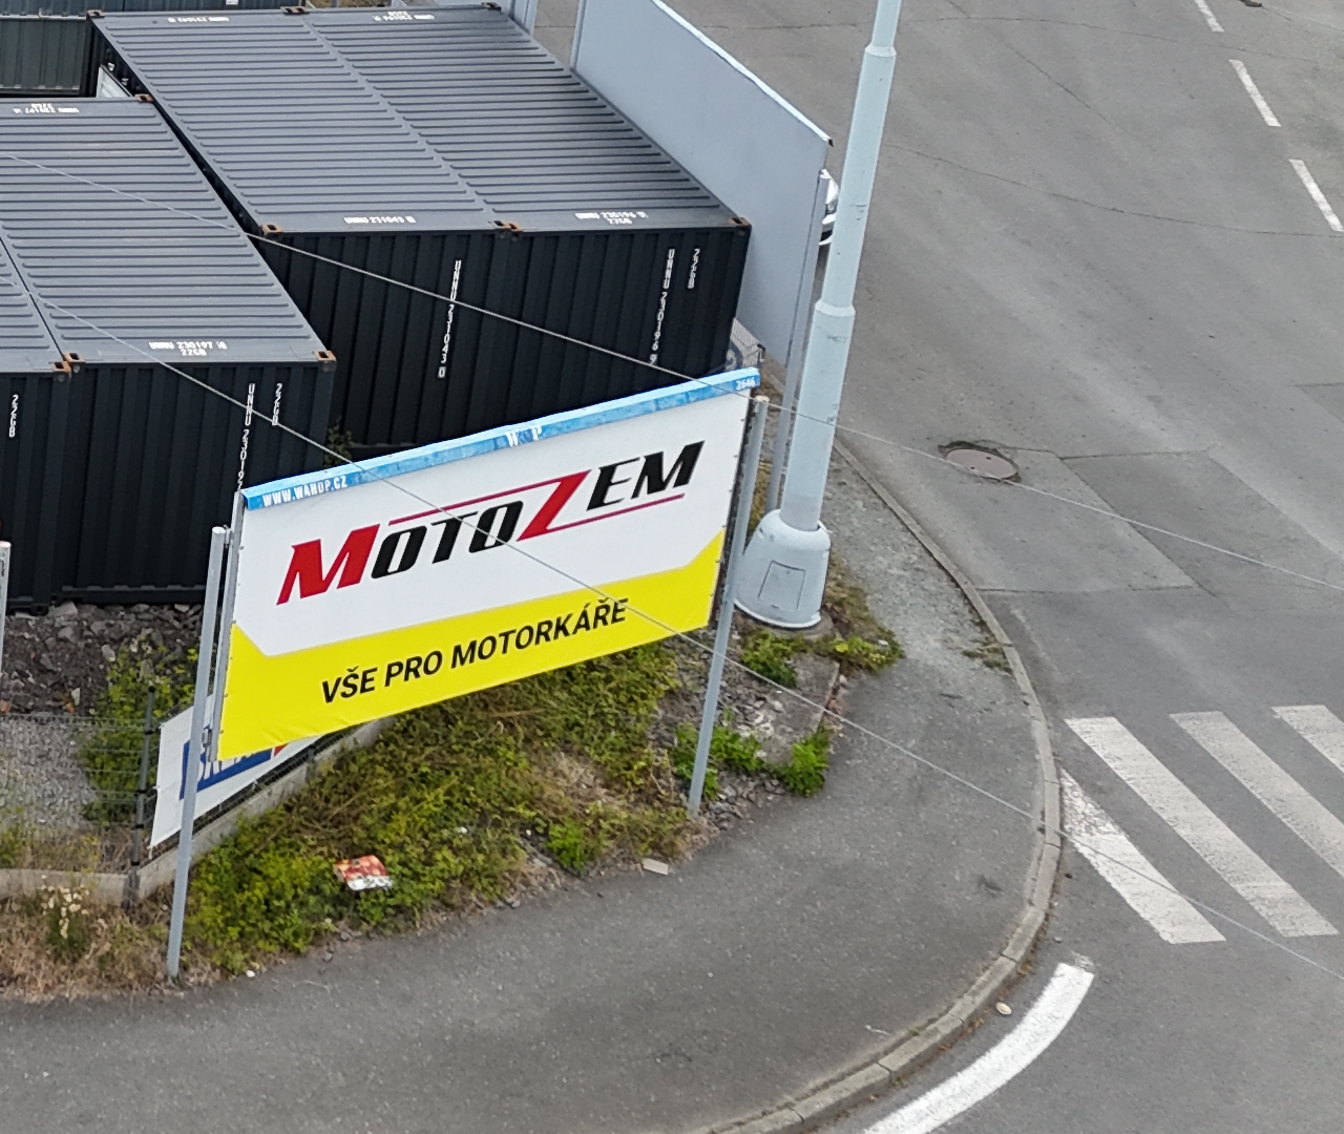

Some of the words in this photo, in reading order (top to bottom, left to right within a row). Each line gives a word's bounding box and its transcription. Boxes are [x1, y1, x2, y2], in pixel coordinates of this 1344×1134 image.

[440, 303, 456, 364] 231043
[437, 366, 447, 378] 0
[244, 382, 256, 427] UNNU
[321, 673, 376, 705] VŠE
[384, 649, 444, 688] PRO
[450, 597, 630, 669] MOTORKÁŘE
